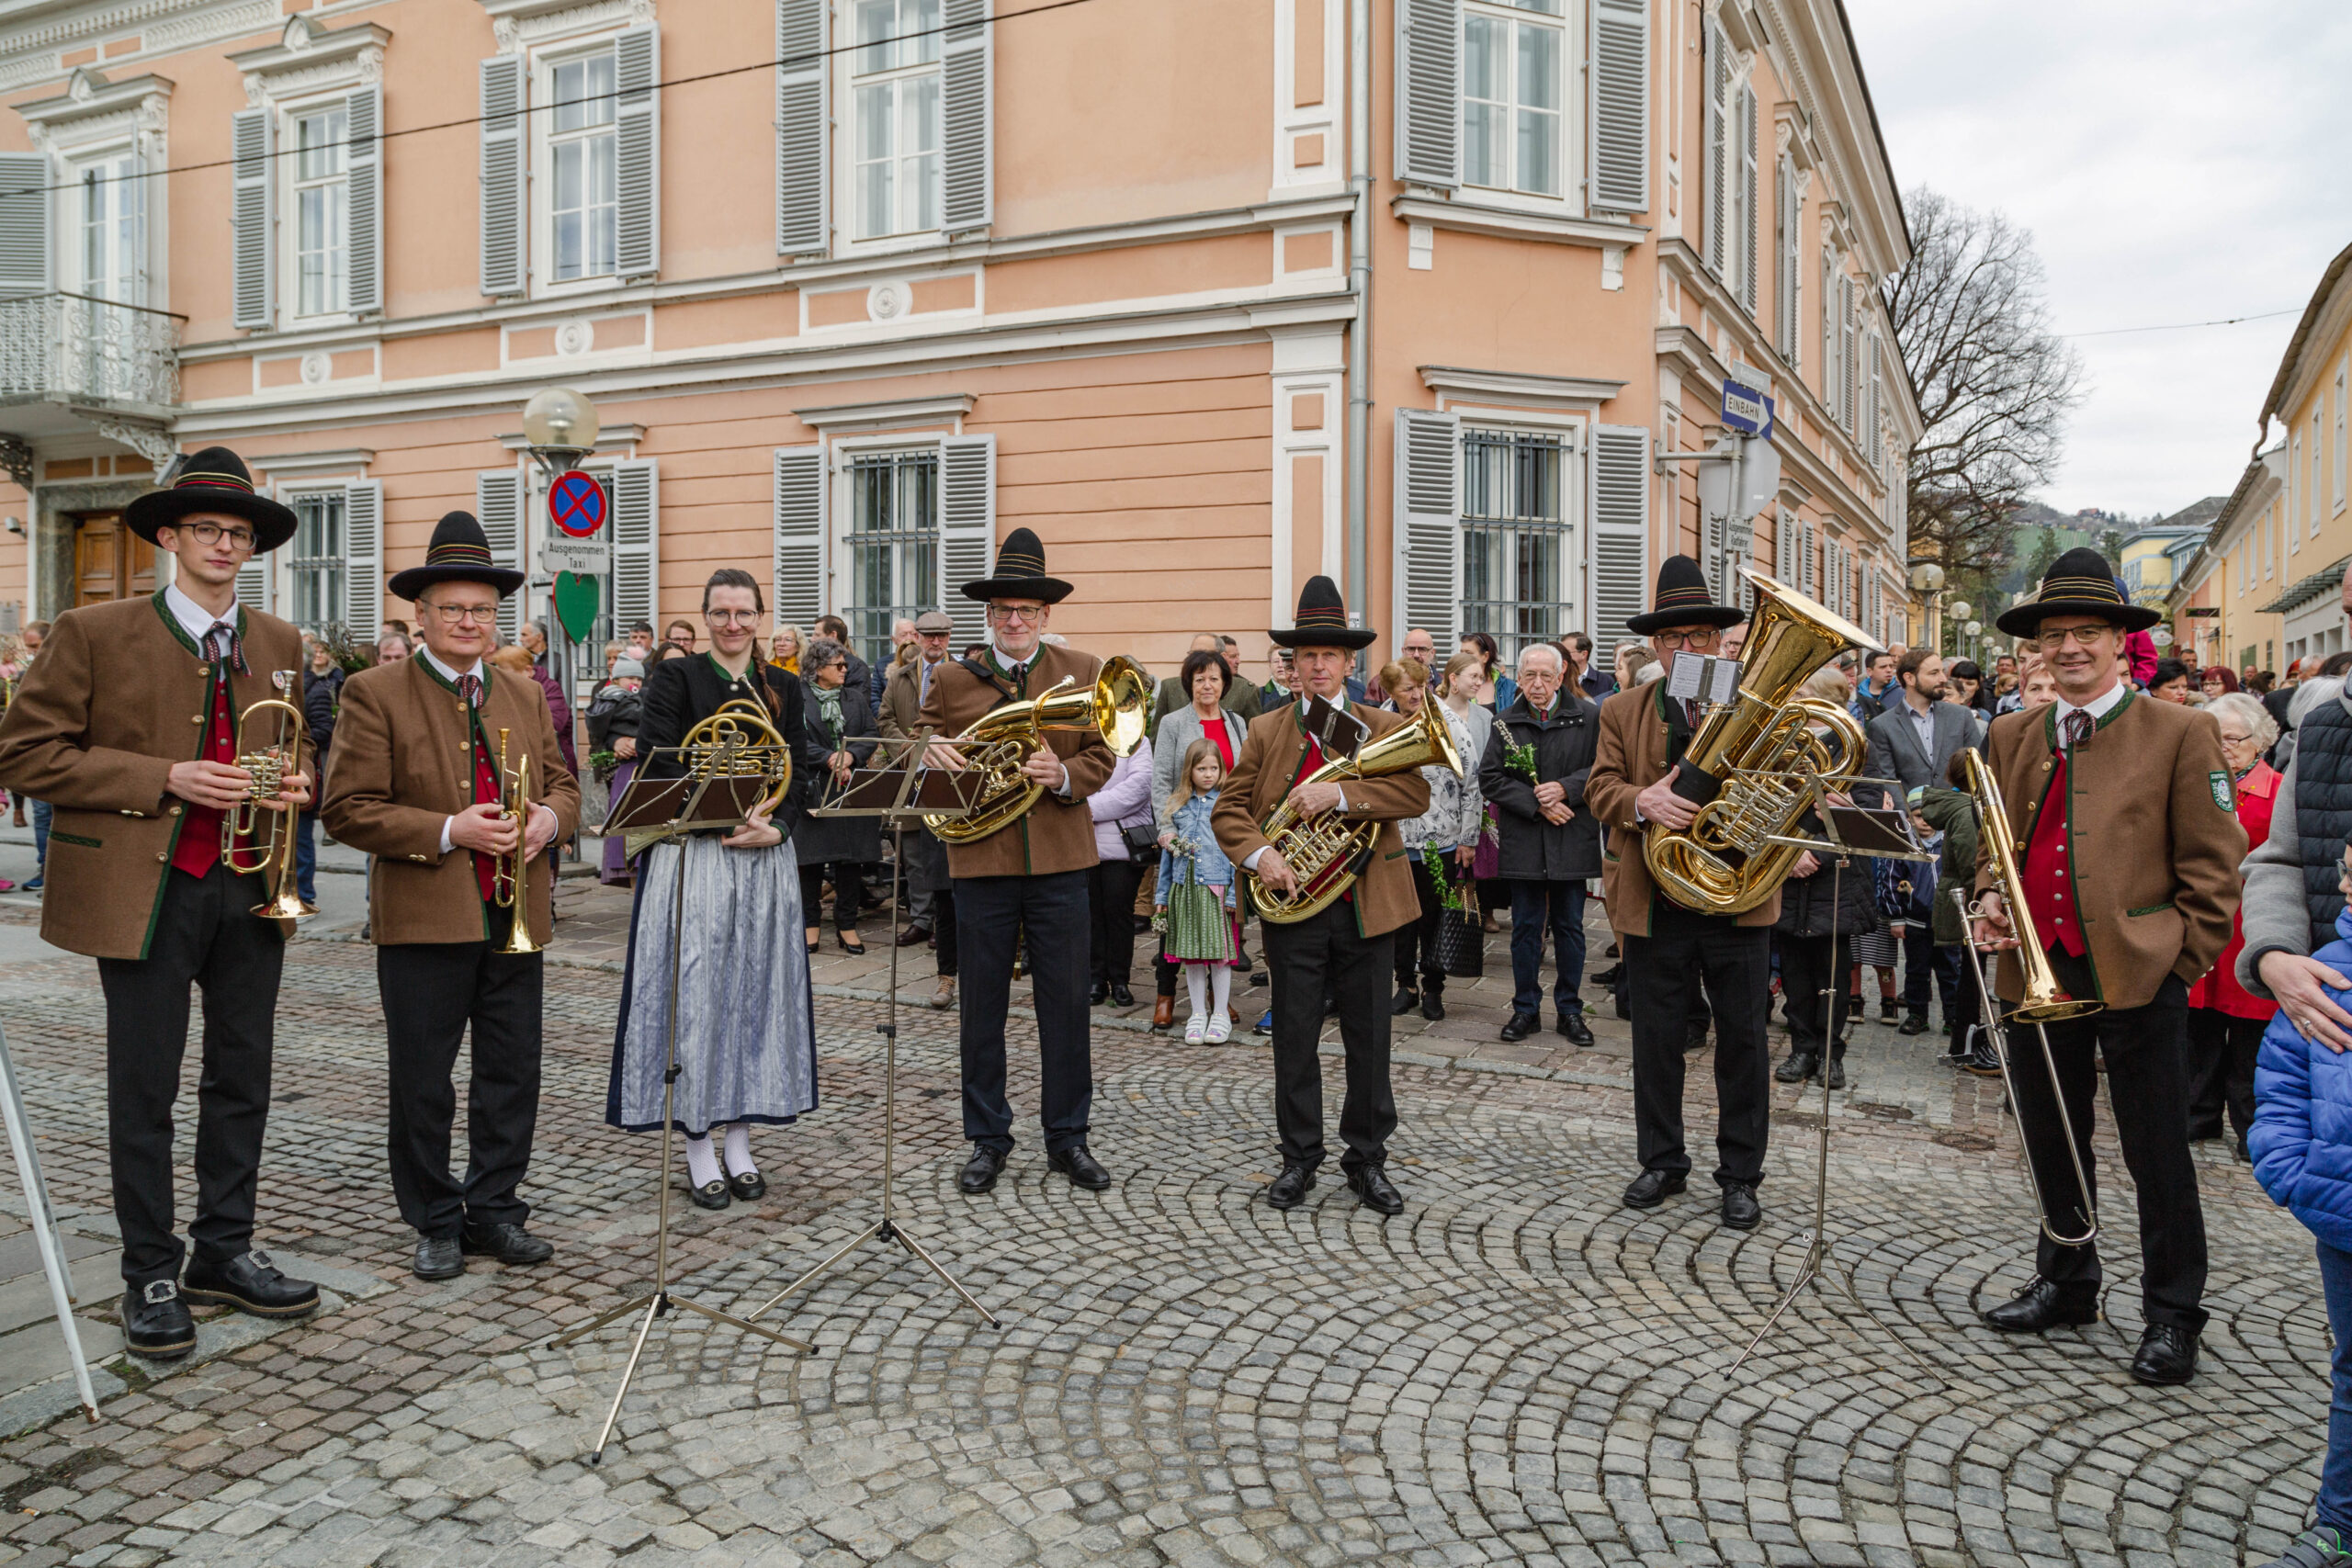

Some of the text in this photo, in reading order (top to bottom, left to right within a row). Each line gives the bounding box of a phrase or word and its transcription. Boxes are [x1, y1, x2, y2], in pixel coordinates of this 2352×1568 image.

[1728, 397, 1759, 419] EINBAHN
[548, 542, 605, 557] Ausgenommen
[569, 556, 586, 569] Taxi
